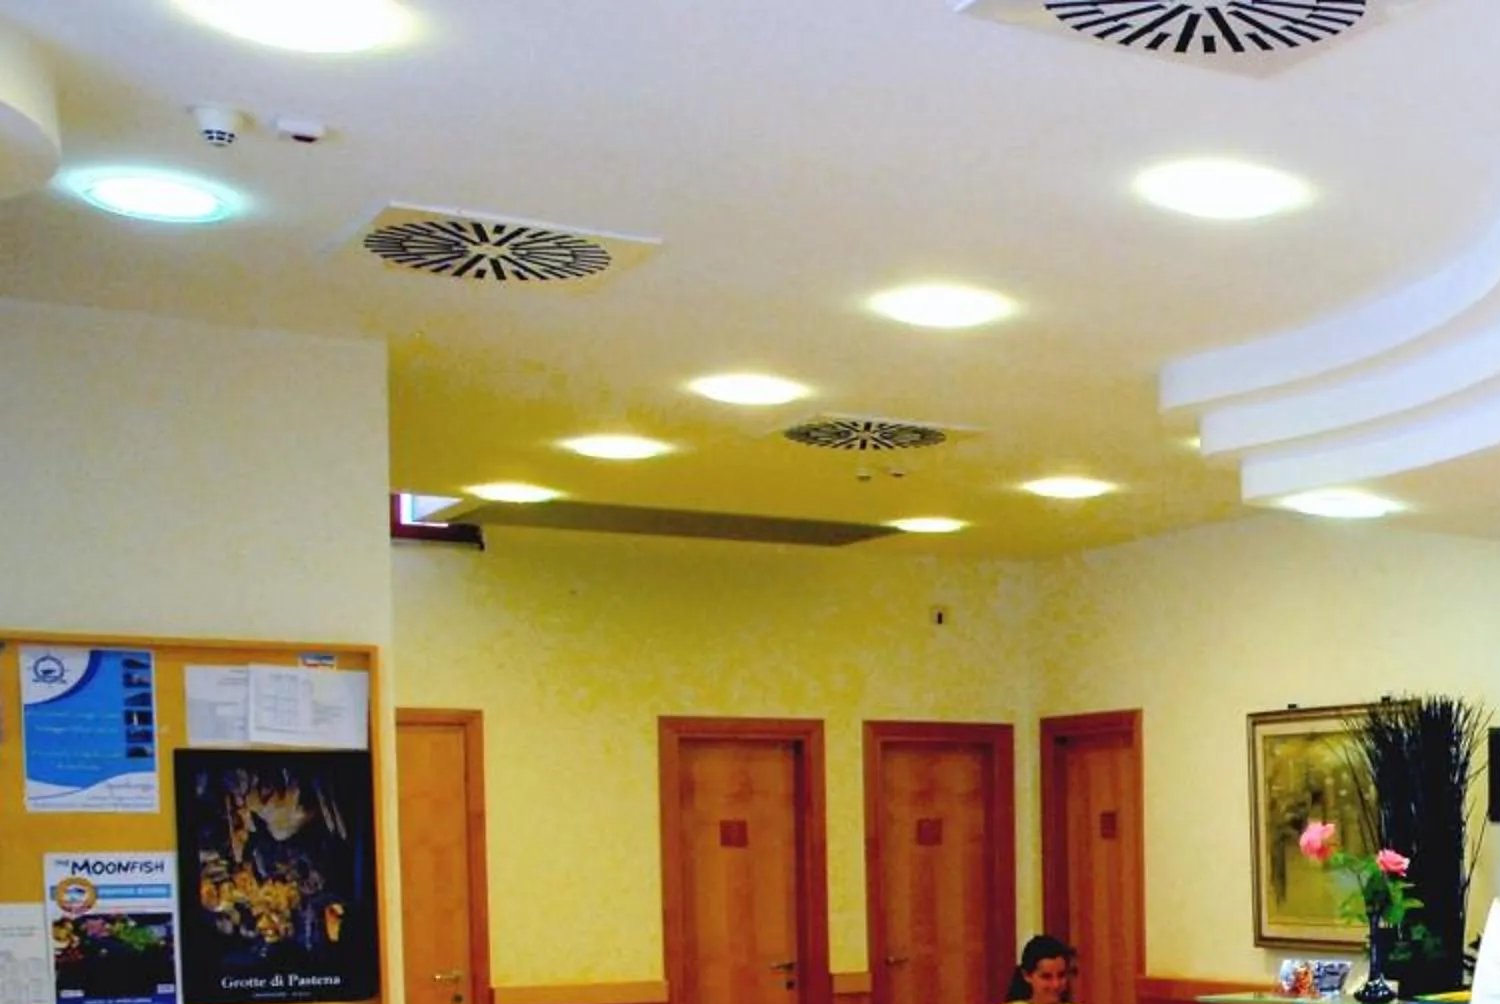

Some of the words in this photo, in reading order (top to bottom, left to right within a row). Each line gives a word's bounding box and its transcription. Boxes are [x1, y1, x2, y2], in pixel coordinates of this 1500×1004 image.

[72, 859, 165, 875] MOONFISH
[220, 976, 267, 989] Grotte
[270, 973, 283, 987] di
[288, 973, 341, 987] Pastena
